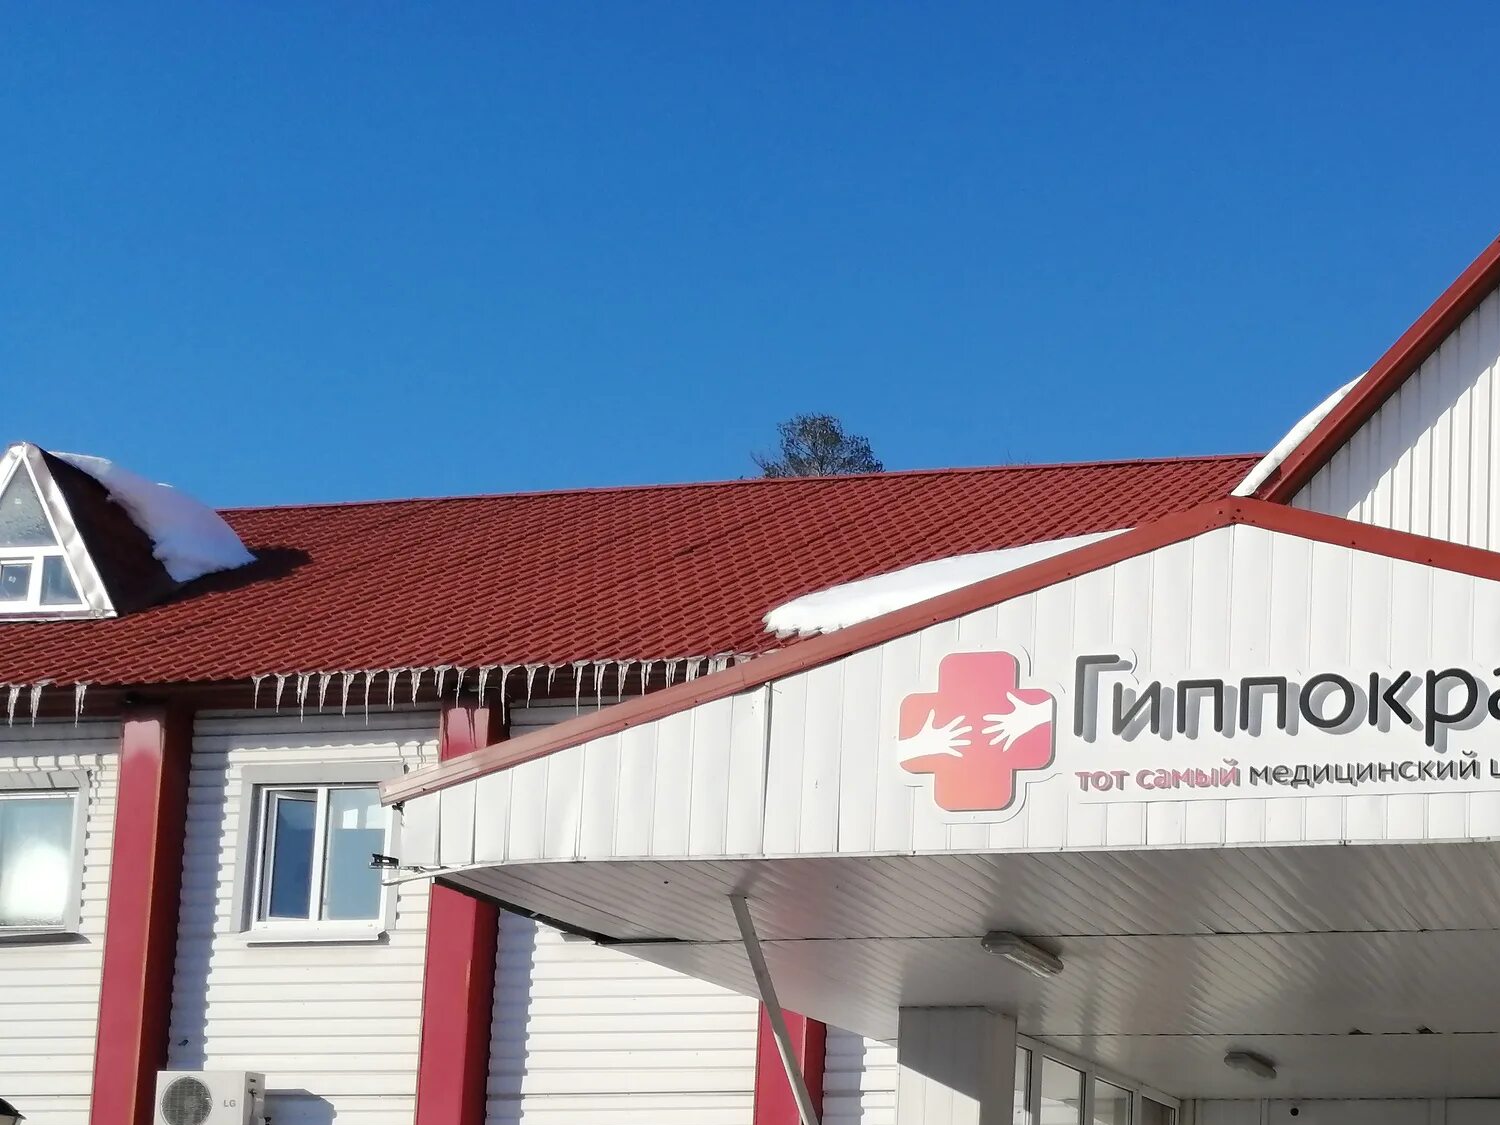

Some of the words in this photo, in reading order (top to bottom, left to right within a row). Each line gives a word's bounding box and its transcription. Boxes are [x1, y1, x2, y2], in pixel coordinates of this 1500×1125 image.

[1076, 766, 1128, 793] тот
[1135, 758, 1241, 791] самый
[1248, 751, 1481, 788] медицинский
[223, 1099, 236, 1108] LG
